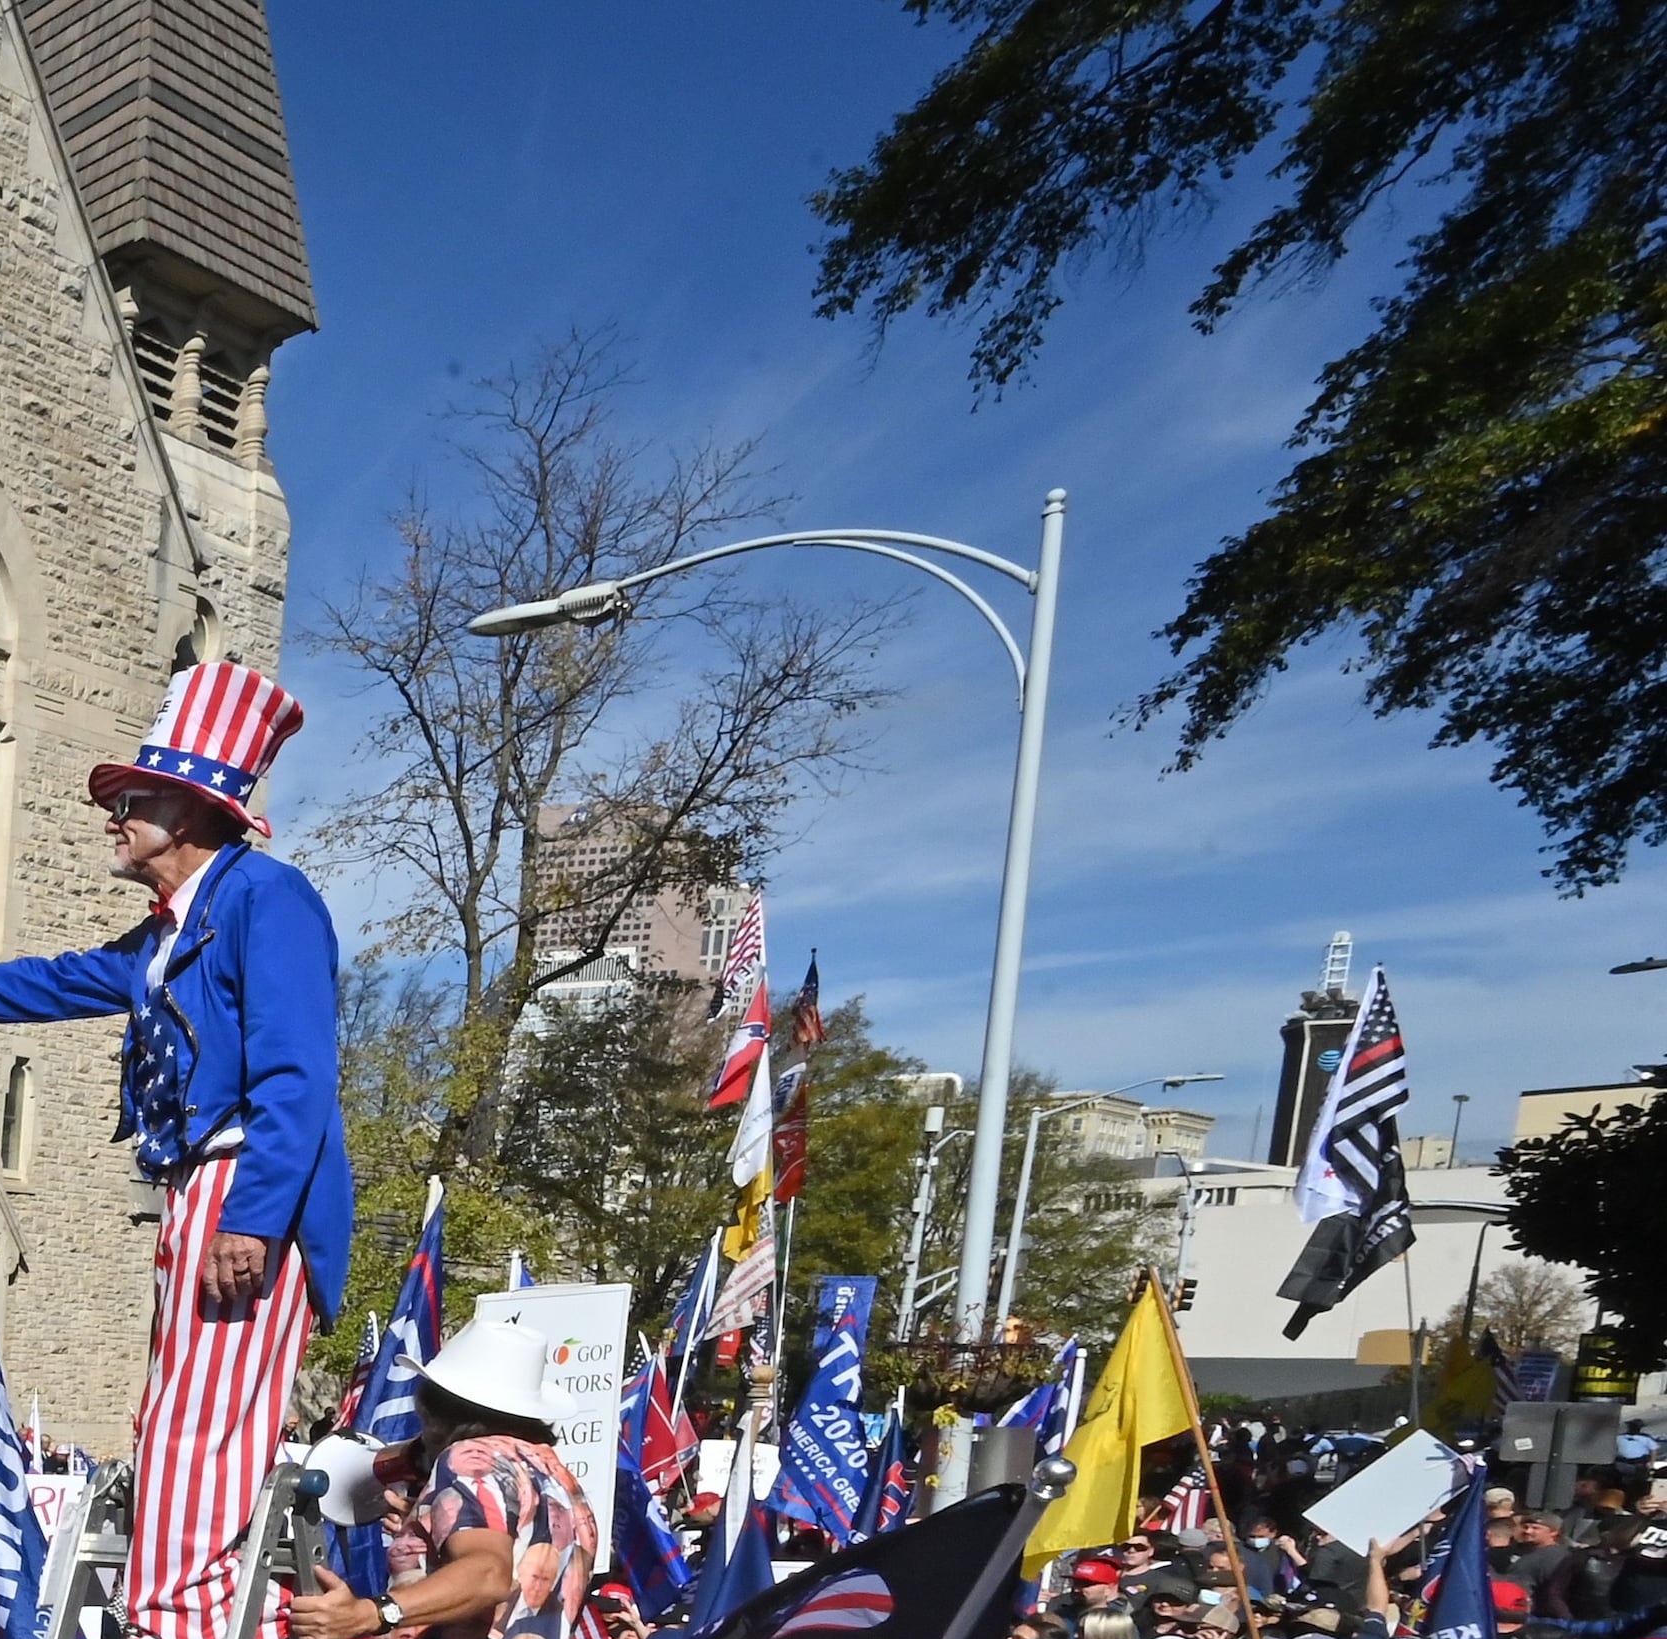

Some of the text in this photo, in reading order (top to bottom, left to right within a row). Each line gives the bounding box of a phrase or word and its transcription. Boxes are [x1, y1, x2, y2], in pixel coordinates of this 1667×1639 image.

[577, 1343, 614, 1368] GOP
[556, 1421, 603, 1453] AGE
[787, 1420, 836, 1483] AMERICA
